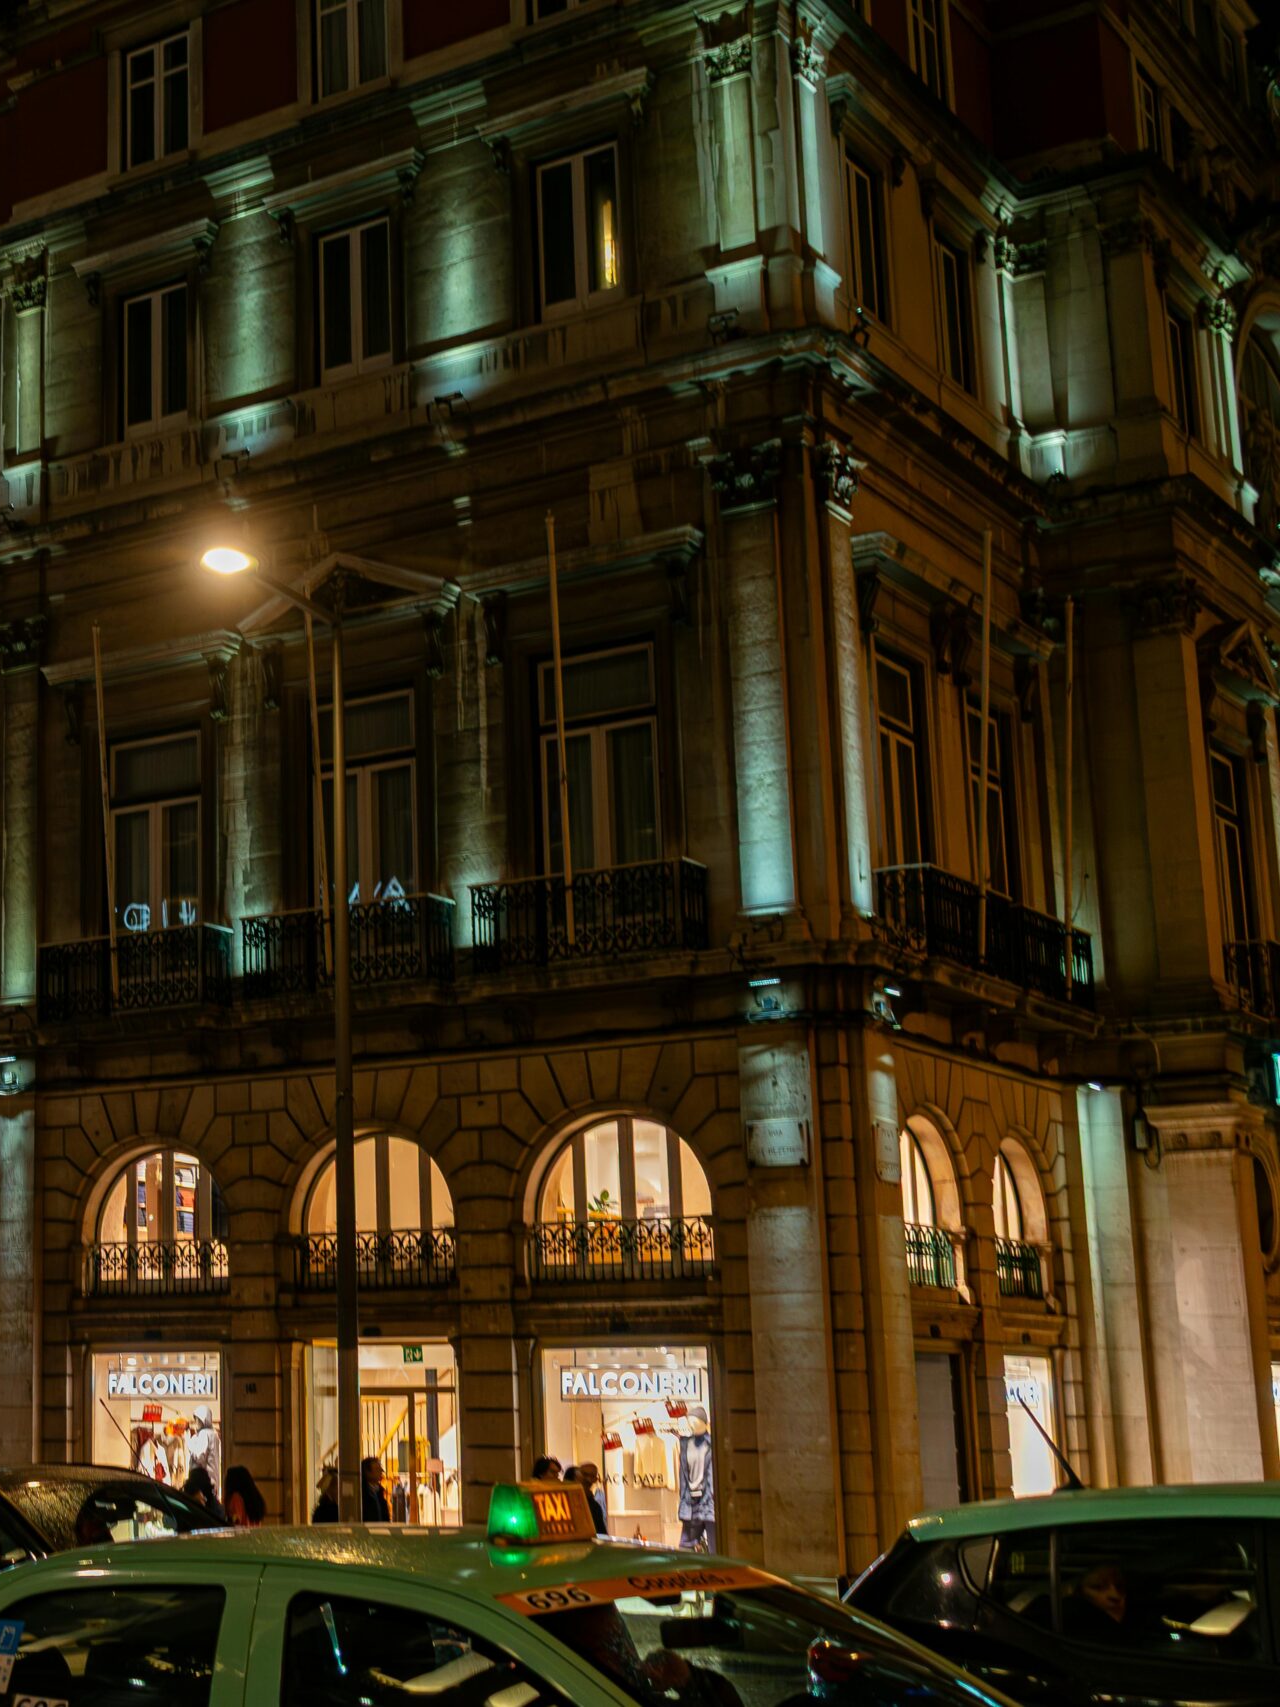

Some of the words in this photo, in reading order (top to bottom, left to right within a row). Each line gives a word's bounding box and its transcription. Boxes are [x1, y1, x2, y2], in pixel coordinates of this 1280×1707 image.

[108, 1373, 213, 1395] FALCONERI
[561, 1371, 696, 1396] FALCONERI
[533, 1491, 572, 1522] TAXI
[527, 1586, 591, 1611] 696
